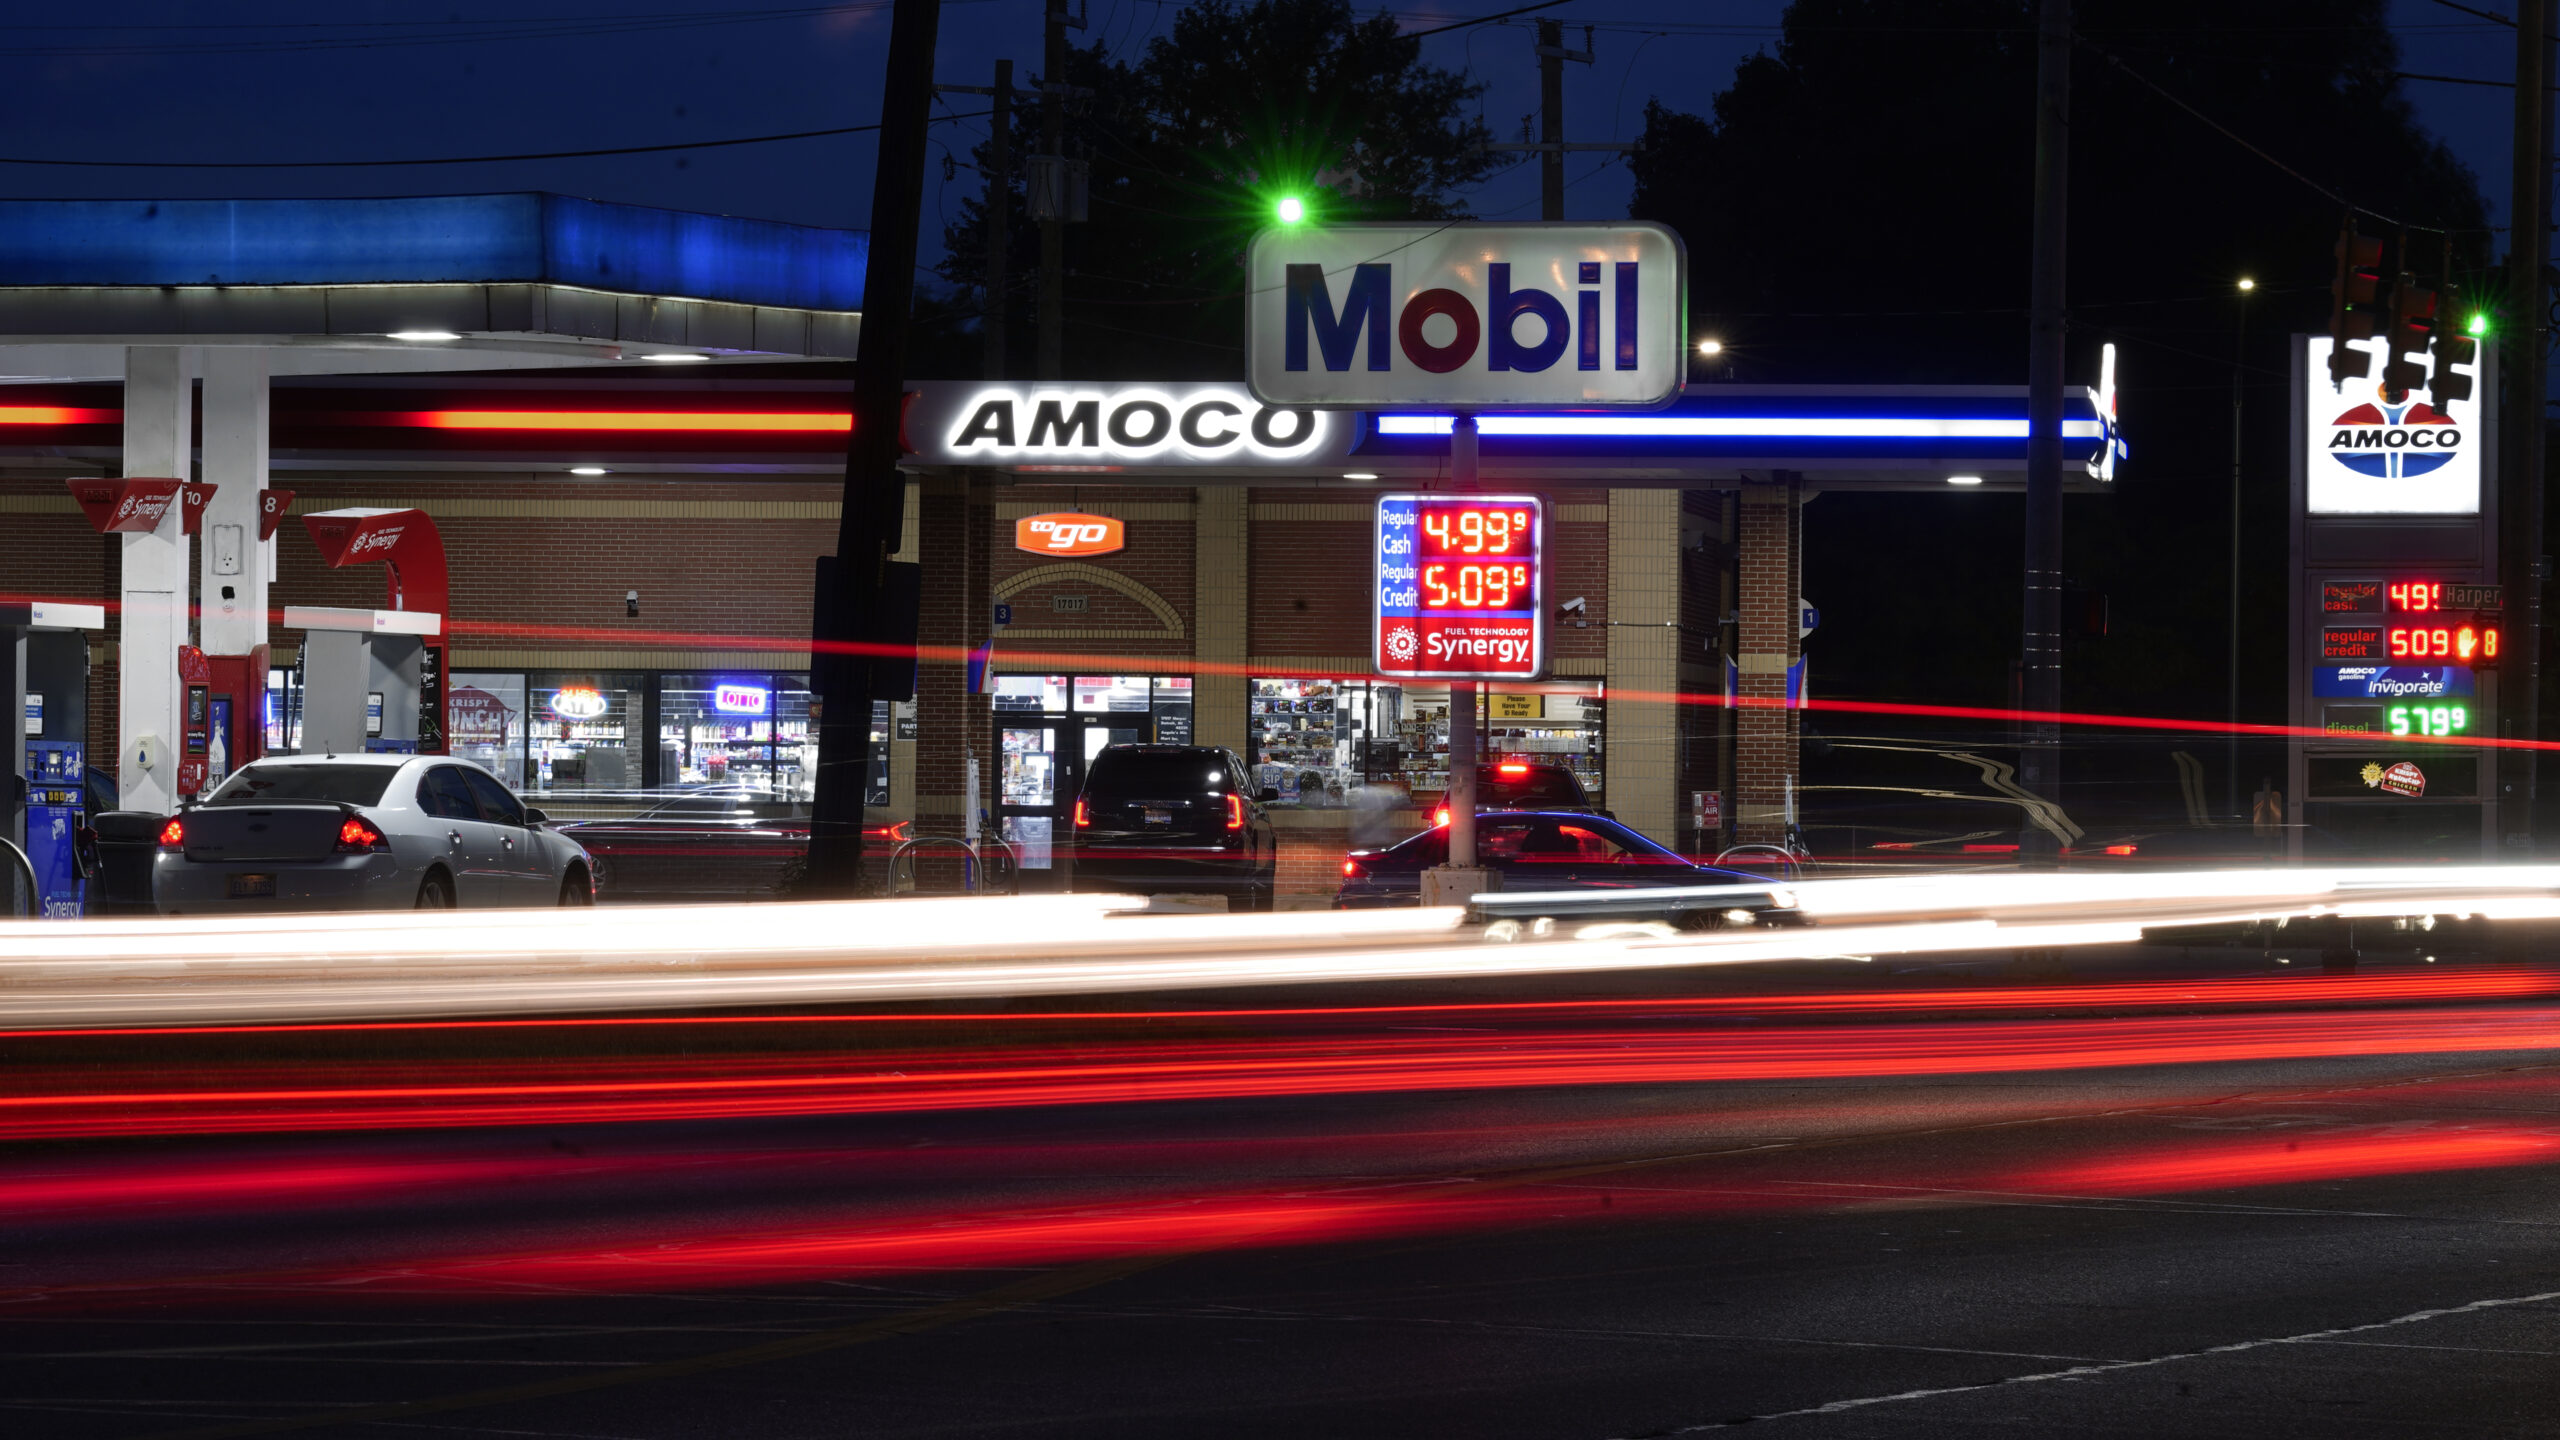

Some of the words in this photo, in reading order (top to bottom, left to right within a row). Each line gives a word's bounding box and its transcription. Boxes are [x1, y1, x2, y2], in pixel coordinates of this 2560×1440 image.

[1285, 261, 1639, 373] Mobil
[952, 400, 1316, 448] AMOCO
[2328, 429, 2462, 448] AMOCO
[186, 491, 201, 505] 10
[264, 497, 277, 512] 8
[132, 499, 167, 519] Synergy
[1382, 509, 1419, 529] Regular
[365, 534, 400, 552] Synergy
[1030, 521, 1056, 532] to
[1048, 524, 1107, 548] go
[1382, 534, 1411, 554] Cash
[1382, 563, 1419, 584] Regular
[1057, 599, 1084, 609] 17017
[1382, 586, 1419, 607] Credit
[2446, 586, 2500, 607] Harper
[999, 608, 1007, 619] 3
[1807, 612, 1813, 623] 1
[1469, 628, 1529, 636] TECHNOLOGY
[2325, 629, 2377, 644] regular
[1427, 632, 1529, 662] Synergy
[2325, 644, 2367, 656] credit
[2484, 629, 2497, 656] 8
[2368, 681, 2444, 696] Invigorate
[449, 699, 490, 707] KRISPY
[449, 708, 517, 731] UNCHY
[2326, 722, 2368, 734] diesel
[1264, 775, 1280, 784] SIP
[1705, 806, 1718, 815] AIR
[44, 896, 81, 920] Synergy
